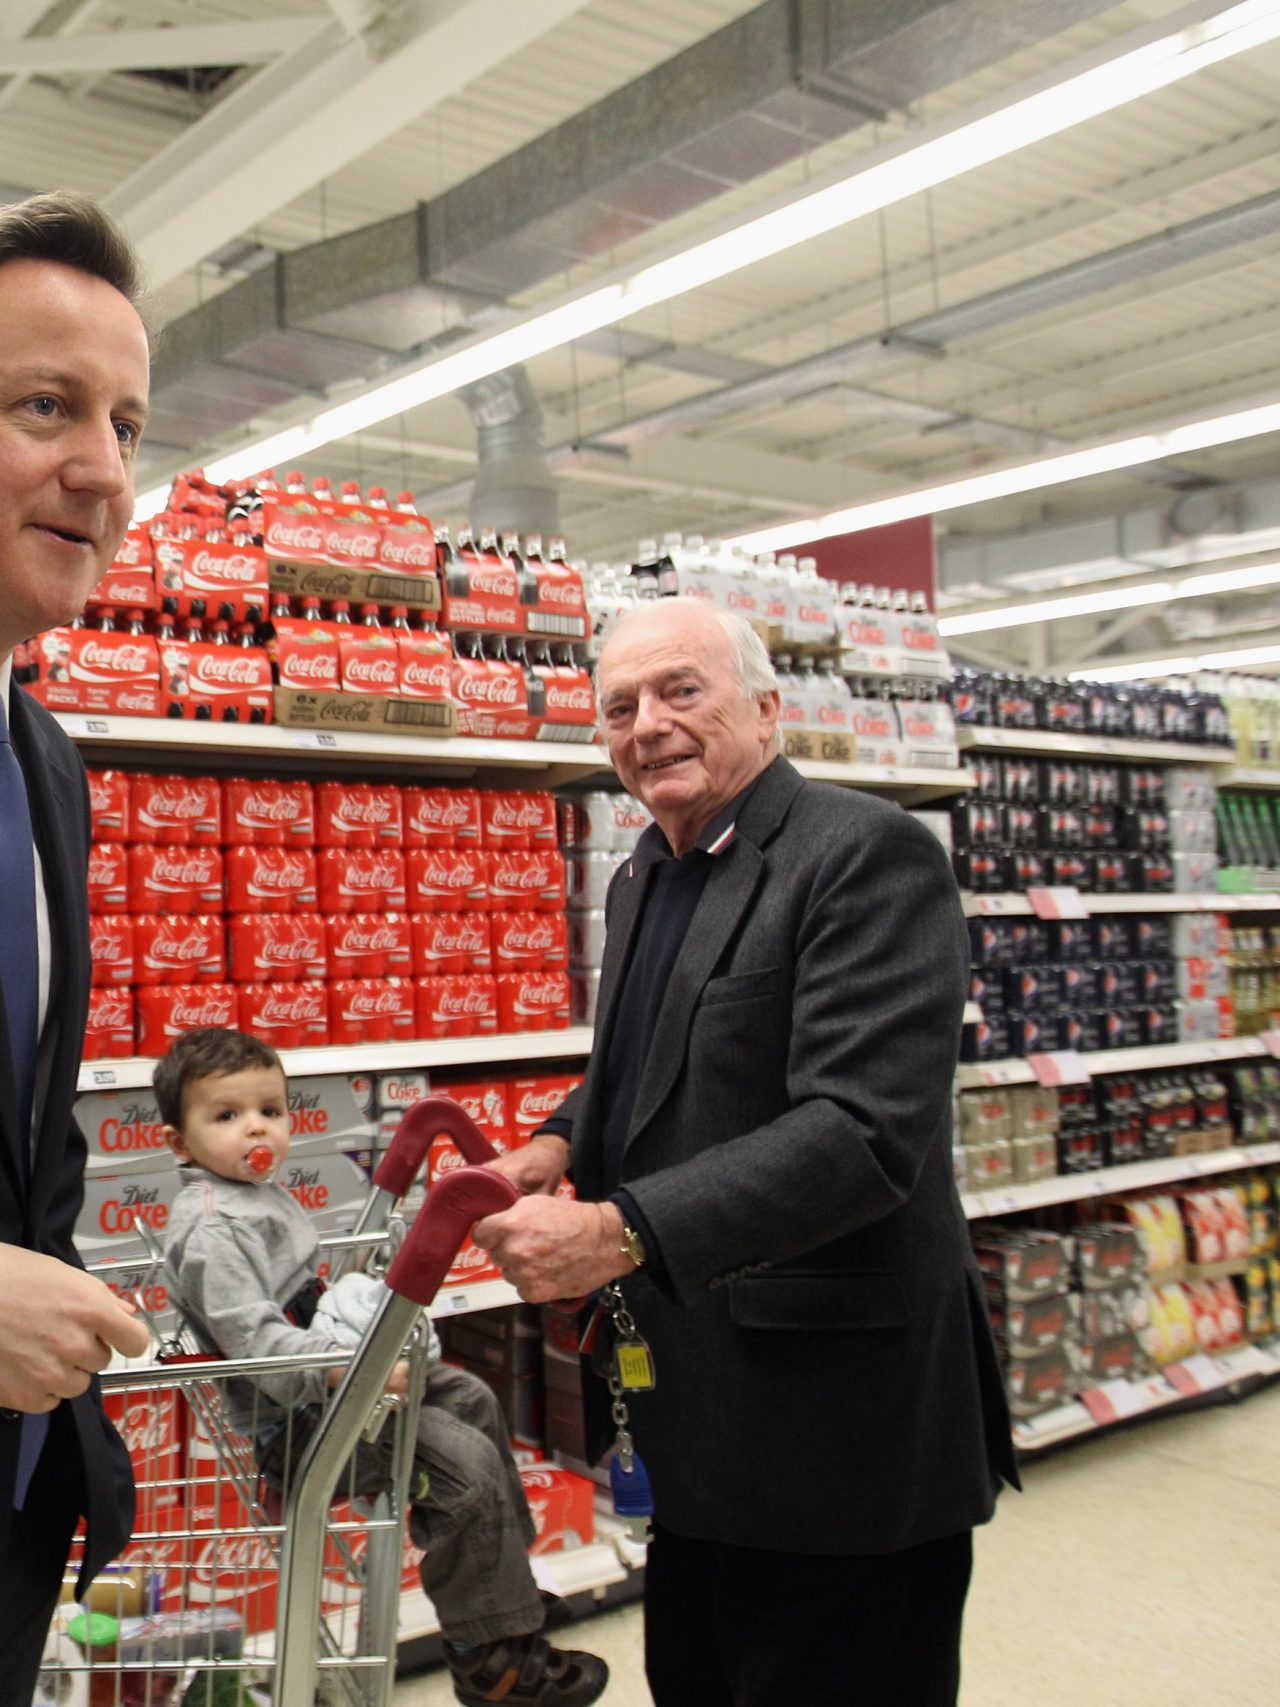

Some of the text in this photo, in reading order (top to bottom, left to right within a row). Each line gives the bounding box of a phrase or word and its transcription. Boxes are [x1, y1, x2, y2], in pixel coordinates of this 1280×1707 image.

[267, 523, 323, 549] Coca-Cola
[327, 532, 380, 557] Coca-Cola
[381, 541, 432, 566] Coca-Cola
[193, 551, 258, 581] Coca-Cola
[470, 573, 515, 596] Coca-Cola
[540, 582, 582, 605] Coca-Cola
[80, 641, 149, 672] Coca-Cola
[284, 654, 338, 679] Coca-Cola
[198, 655, 262, 684] Coca-Cola
[345, 658, 397, 683] Coca-Cola
[404, 662, 452, 687] Coca-Cola
[458, 674, 518, 703] Coca-Cola
[547, 686, 593, 709] Coca-Cola
[147, 794, 207, 818] Coca-Cola
[243, 796, 301, 819] Coca-Cola
[339, 801, 391, 822] Coca-Cola
[419, 802, 469, 825] Coca-Cola
[493, 806, 543, 826] Coca-Cola
[153, 857, 214, 883] Coca-Cola
[254, 866, 305, 888] Coca-Cola
[346, 866, 396, 887] Coca-Cola
[425, 864, 474, 887] Coca-Cola
[495, 866, 551, 888] Coca-Cola
[151, 936, 209, 960] Coca-Cola
[263, 938, 318, 960] Coca-Cola
[343, 929, 400, 949] Coca-Cola
[433, 930, 485, 950] Coca-Cola
[504, 928, 558, 948] Coca-Cola
[350, 992, 402, 1012] Coca-Cola
[440, 994, 493, 1013] Coca-Cola
[520, 983, 566, 1004] Coca-Cola
[171, 1001, 231, 1025] Coca-Cola
[261, 997, 325, 1020] Coca-Cola
[388, 1082, 420, 1100] Coke
[121, 1105, 159, 1125] Diet
[99, 1119, 168, 1152] Coke
[288, 1168, 319, 1187] Diet
[121, 1186, 159, 1206] Diet
[99, 1201, 168, 1234] Coke
